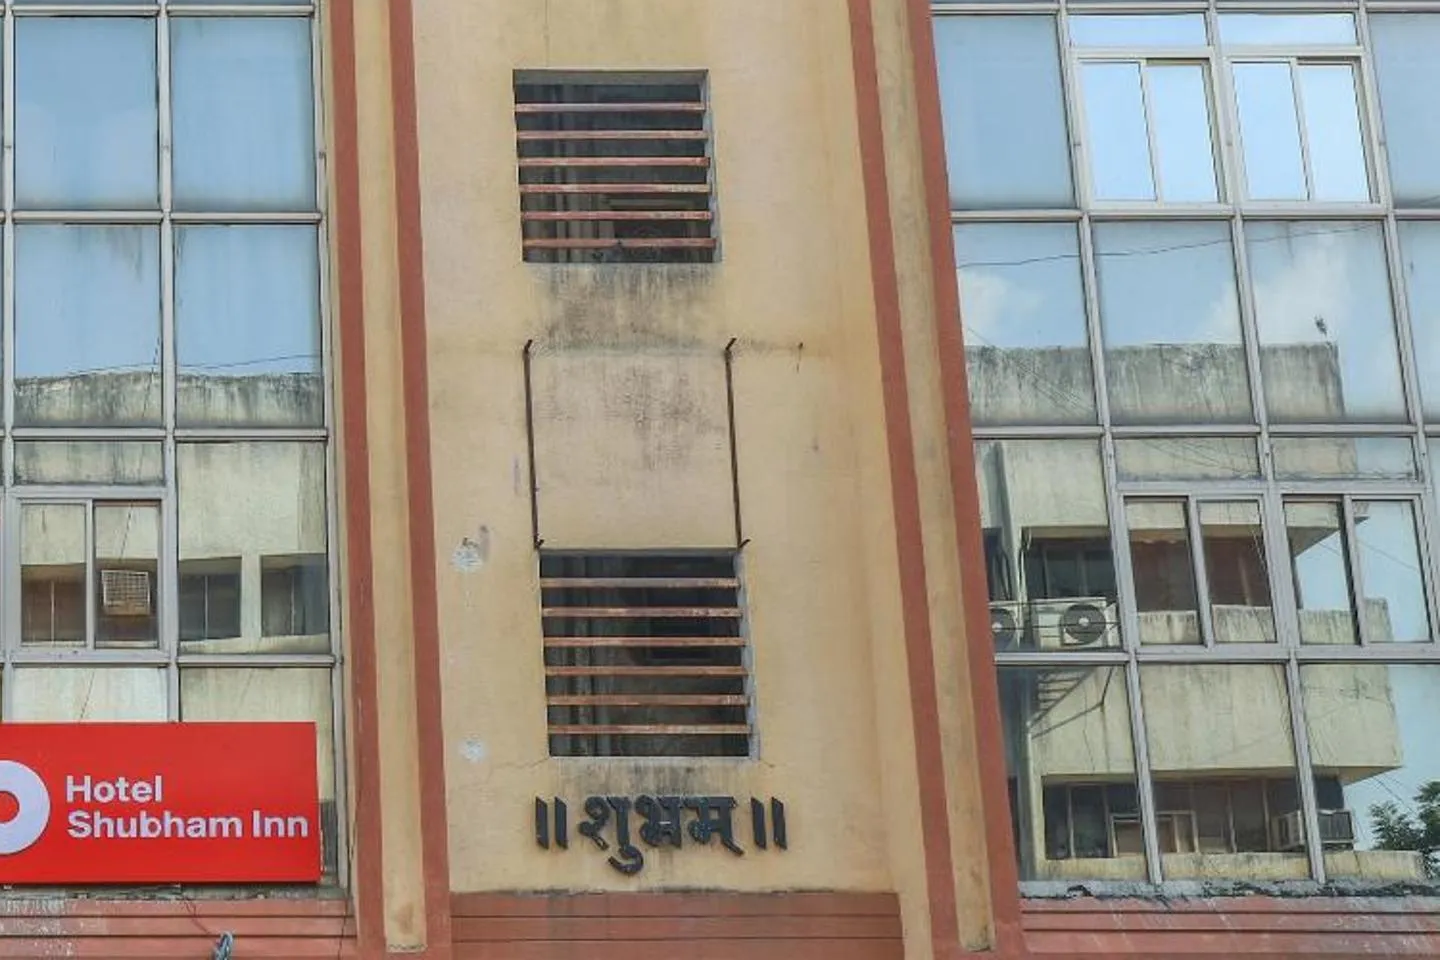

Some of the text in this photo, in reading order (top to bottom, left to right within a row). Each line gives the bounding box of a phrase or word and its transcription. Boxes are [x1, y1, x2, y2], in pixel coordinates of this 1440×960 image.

[66, 775, 163, 803] Hotel
[67, 810, 309, 839] Shubham Inn
